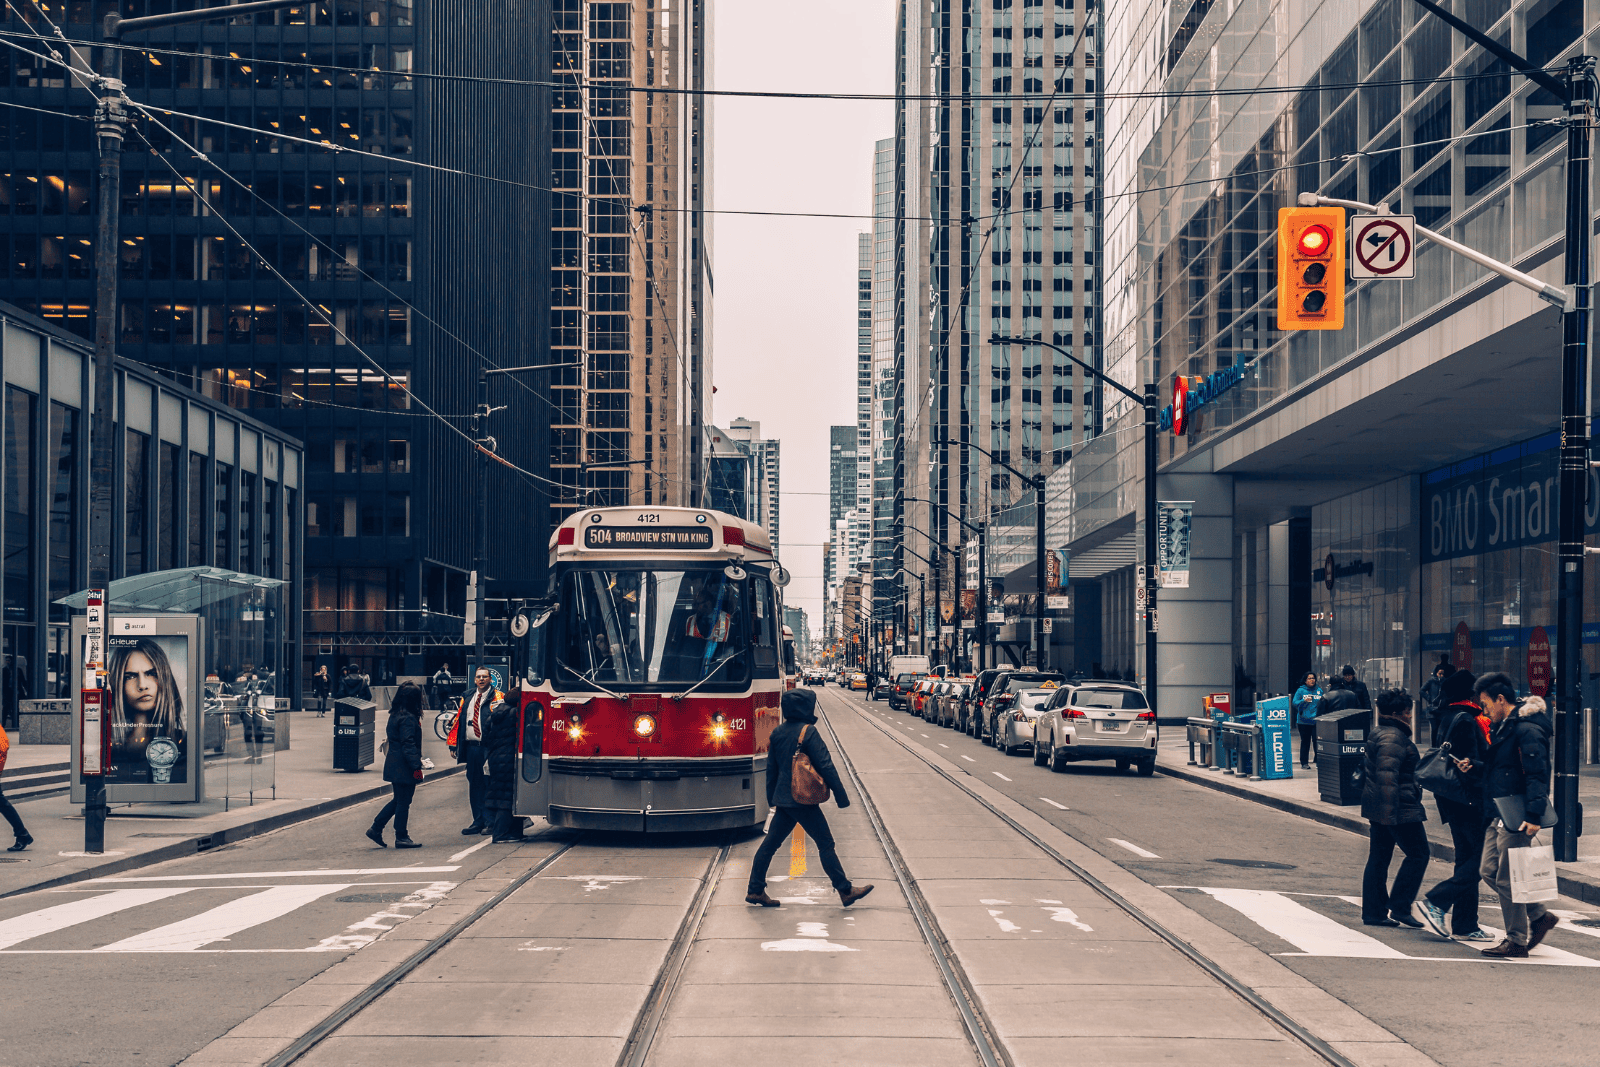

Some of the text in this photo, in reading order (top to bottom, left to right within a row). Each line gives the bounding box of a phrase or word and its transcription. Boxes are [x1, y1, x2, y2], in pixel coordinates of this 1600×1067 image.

[637, 514, 660, 523] 4121
[1431, 485, 1479, 557] BMO
[1489, 474, 1560, 546] Smar
[590, 529, 709, 544] 504 BROADVIEW STN VIA KING
[1159, 505, 1169, 568] OPPORTUNITY
[87, 591, 102, 599] 24hr
[34, 702, 72, 711] THE T
[1267, 709, 1287, 718] JOB
[552, 719, 566, 732] 4121
[730, 718, 747, 731] 4121
[1272, 731, 1285, 773] FREE
[1342, 745, 1358, 754] Litter
